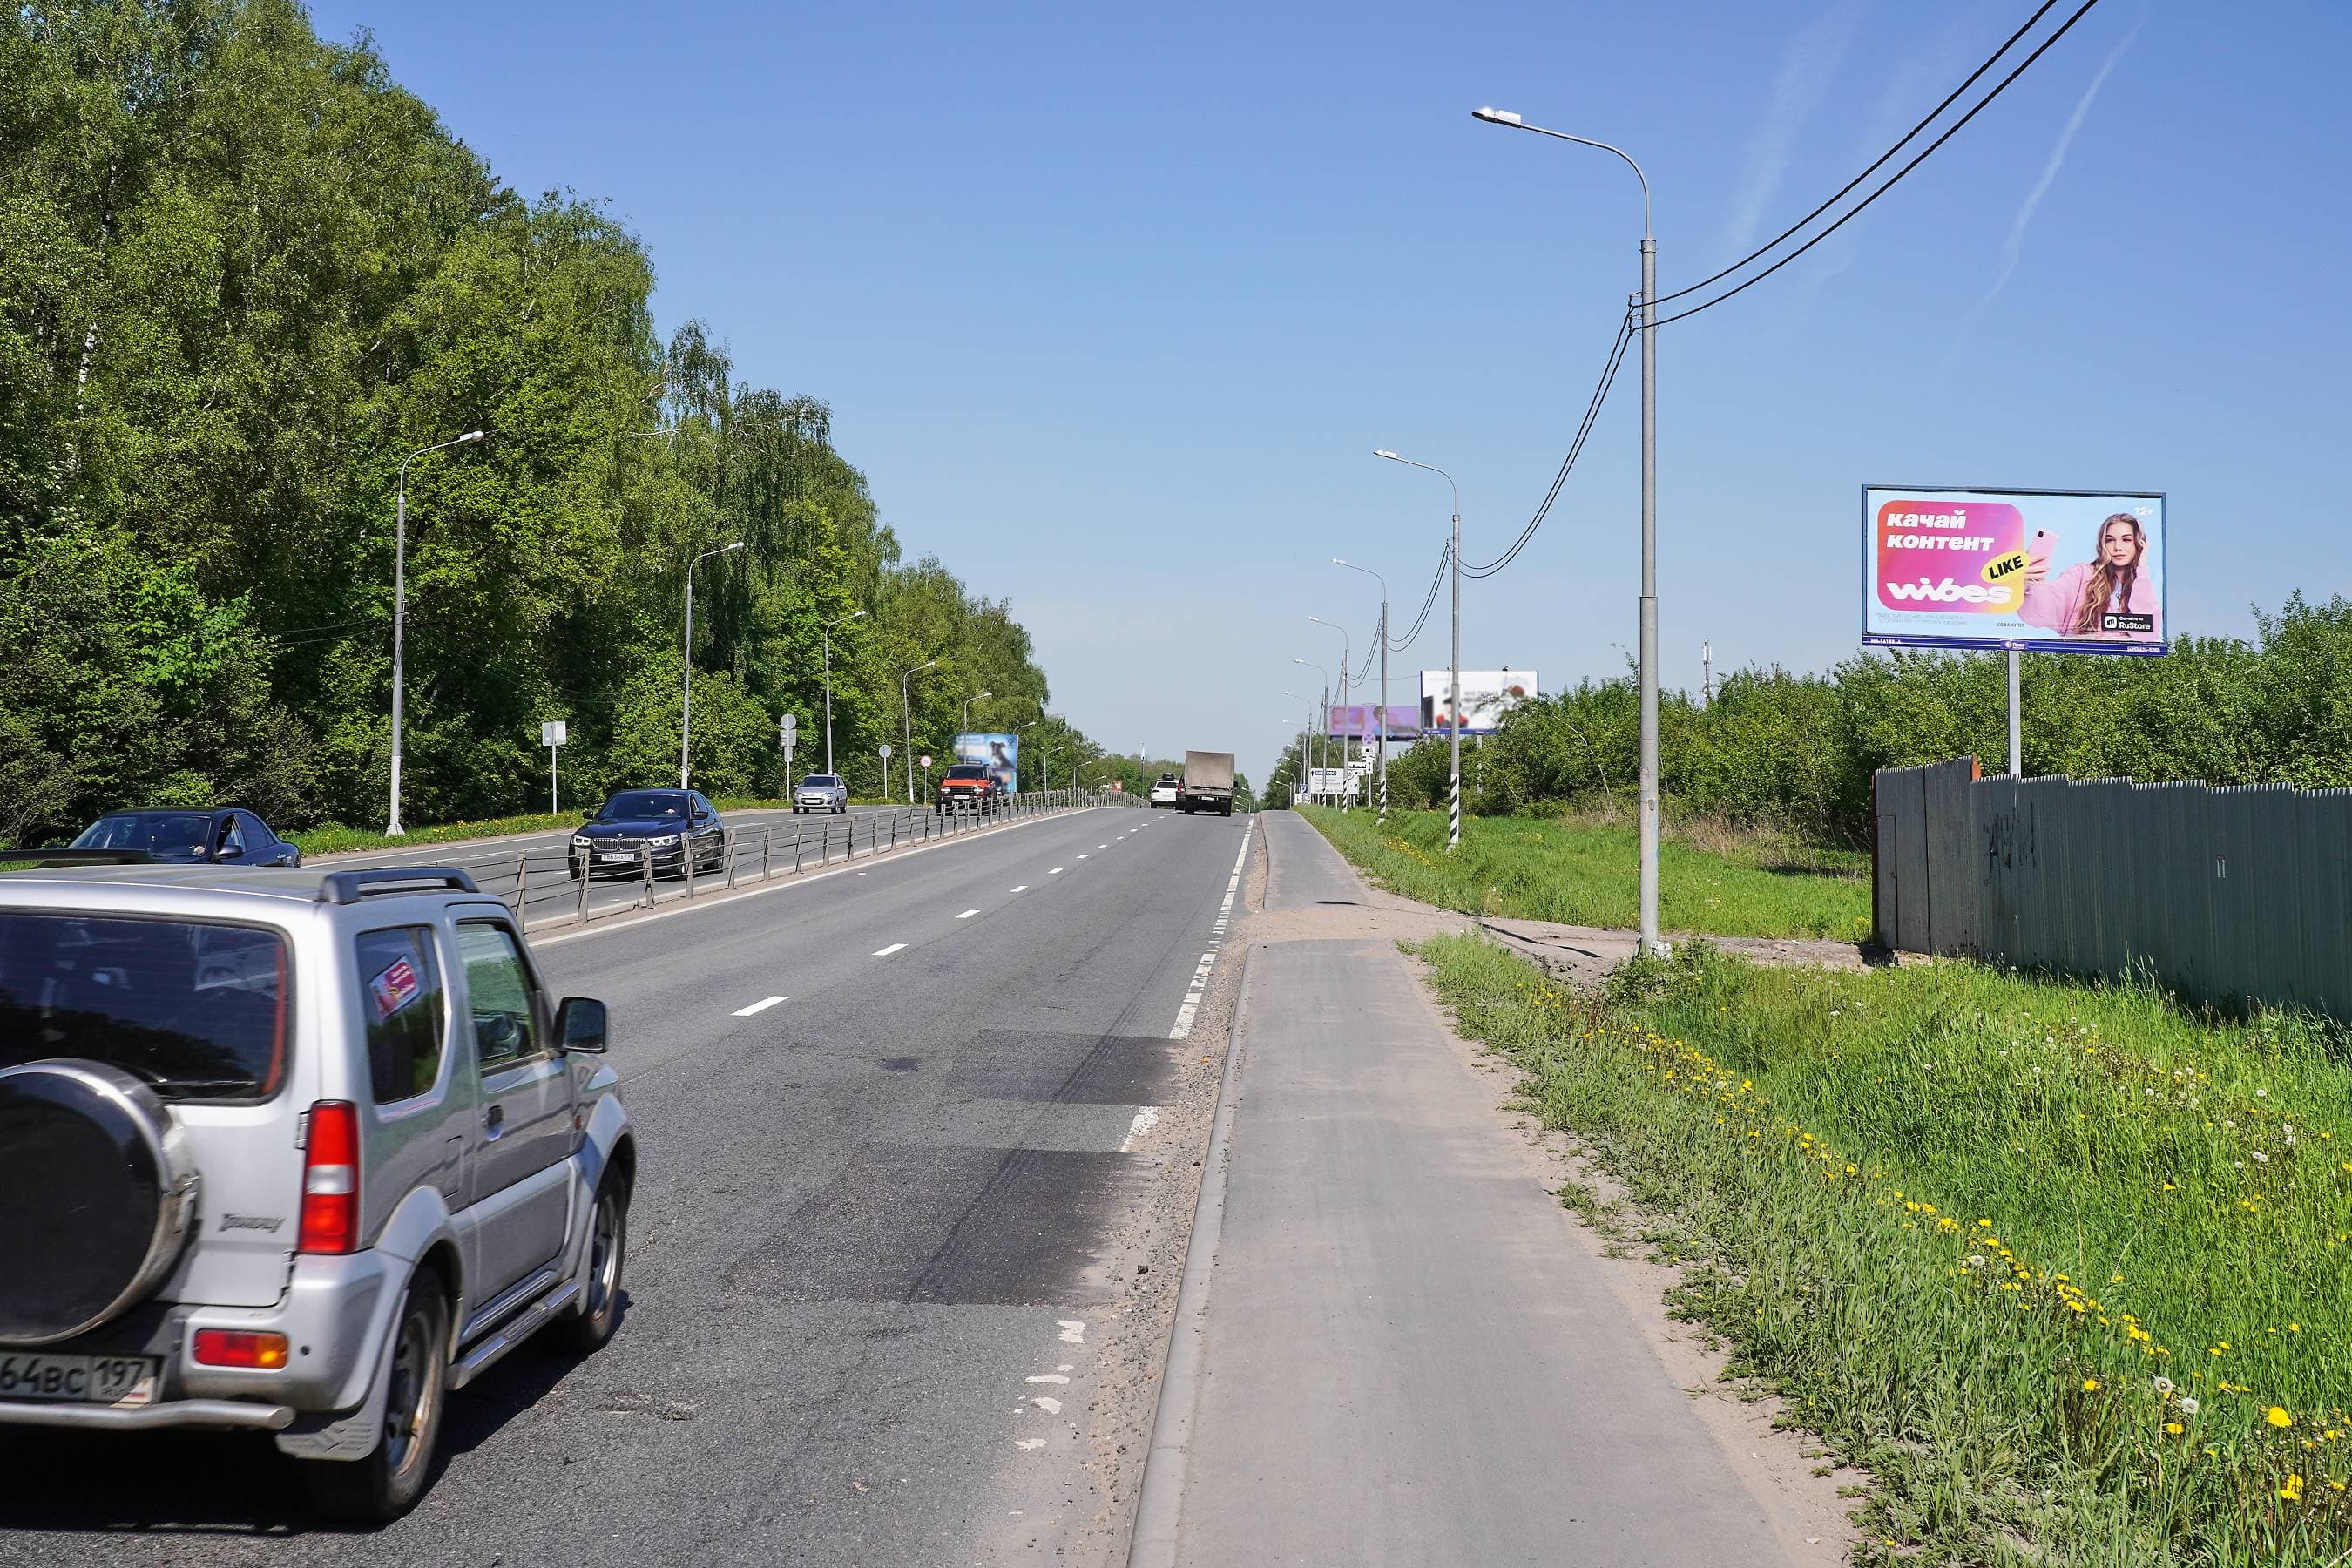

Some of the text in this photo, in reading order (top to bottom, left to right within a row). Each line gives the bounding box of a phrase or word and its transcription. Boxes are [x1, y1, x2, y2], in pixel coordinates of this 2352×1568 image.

[1886, 509, 1967, 529] качай
[1886, 534, 1995, 551] контент
[1989, 555, 2024, 580] LIKE
[2119, 621, 2151, 630] RuStore
[92, 1359, 147, 1388] 197
